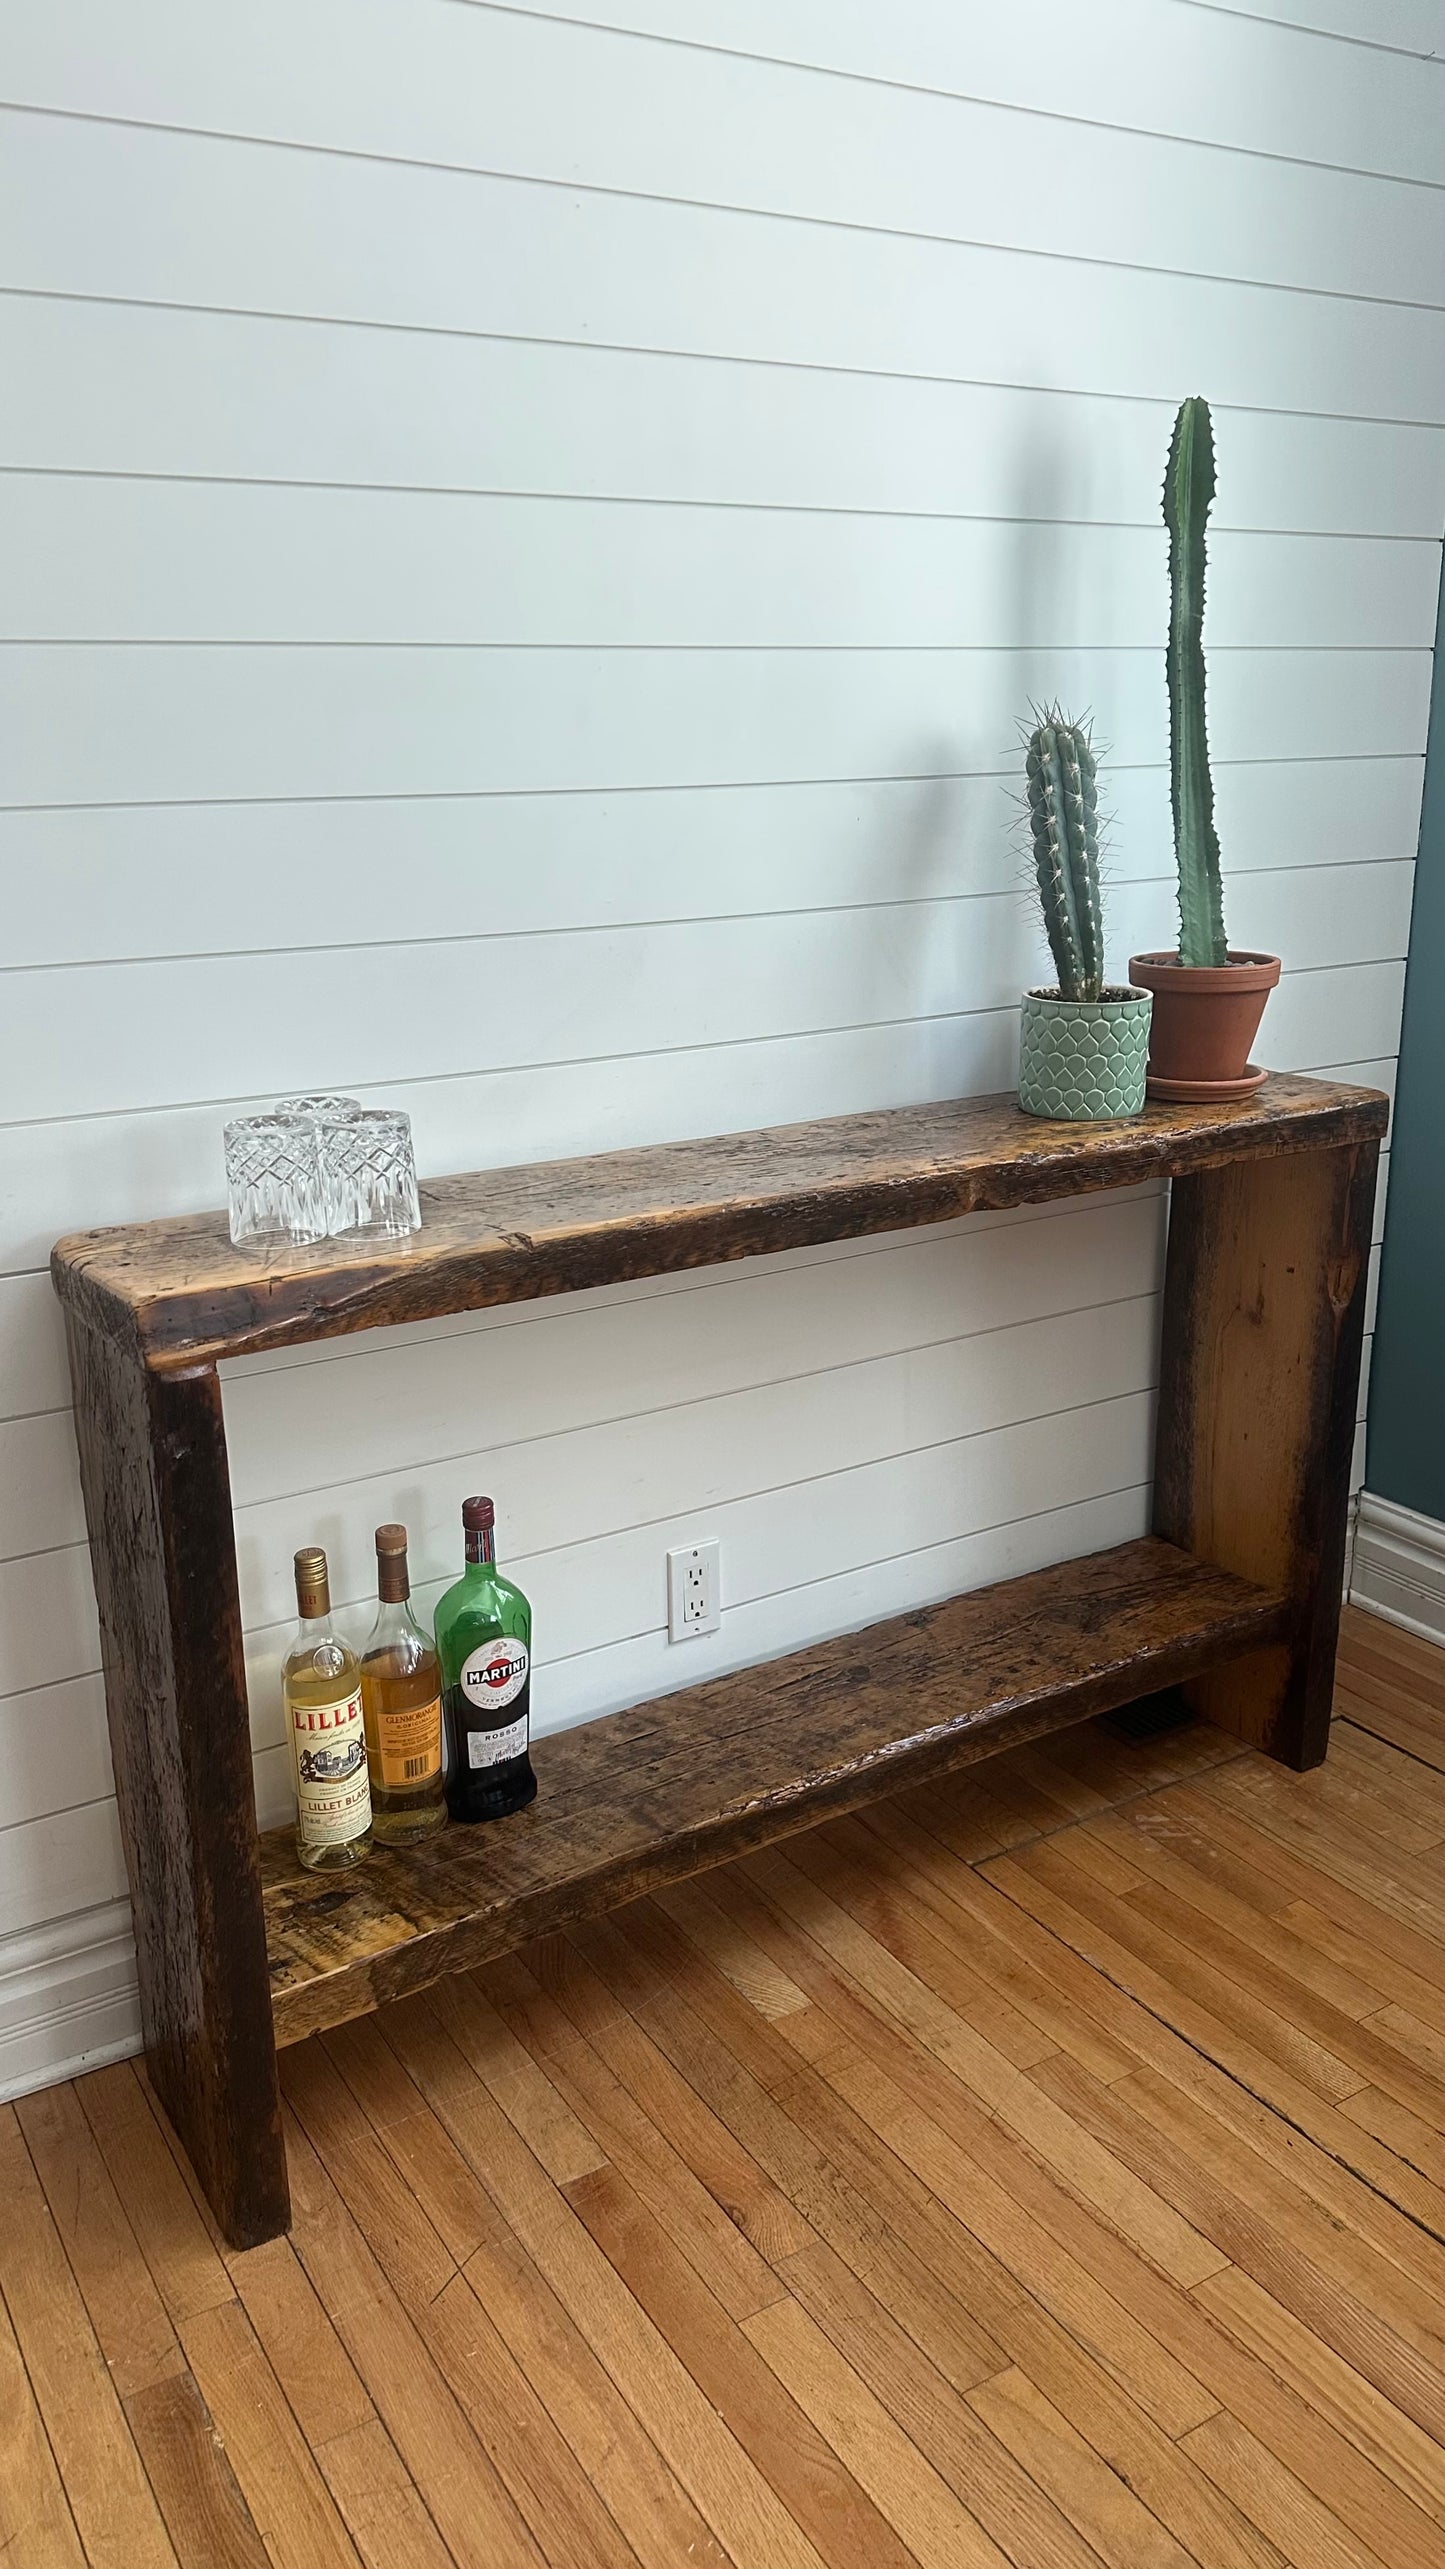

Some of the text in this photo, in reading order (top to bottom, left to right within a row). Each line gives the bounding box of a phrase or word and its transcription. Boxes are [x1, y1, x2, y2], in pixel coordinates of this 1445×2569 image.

[469, 1658, 525, 1684] MARTINI
[485, 1726, 517, 1741] ROSSO
[308, 1800, 342, 1812] LILLET
